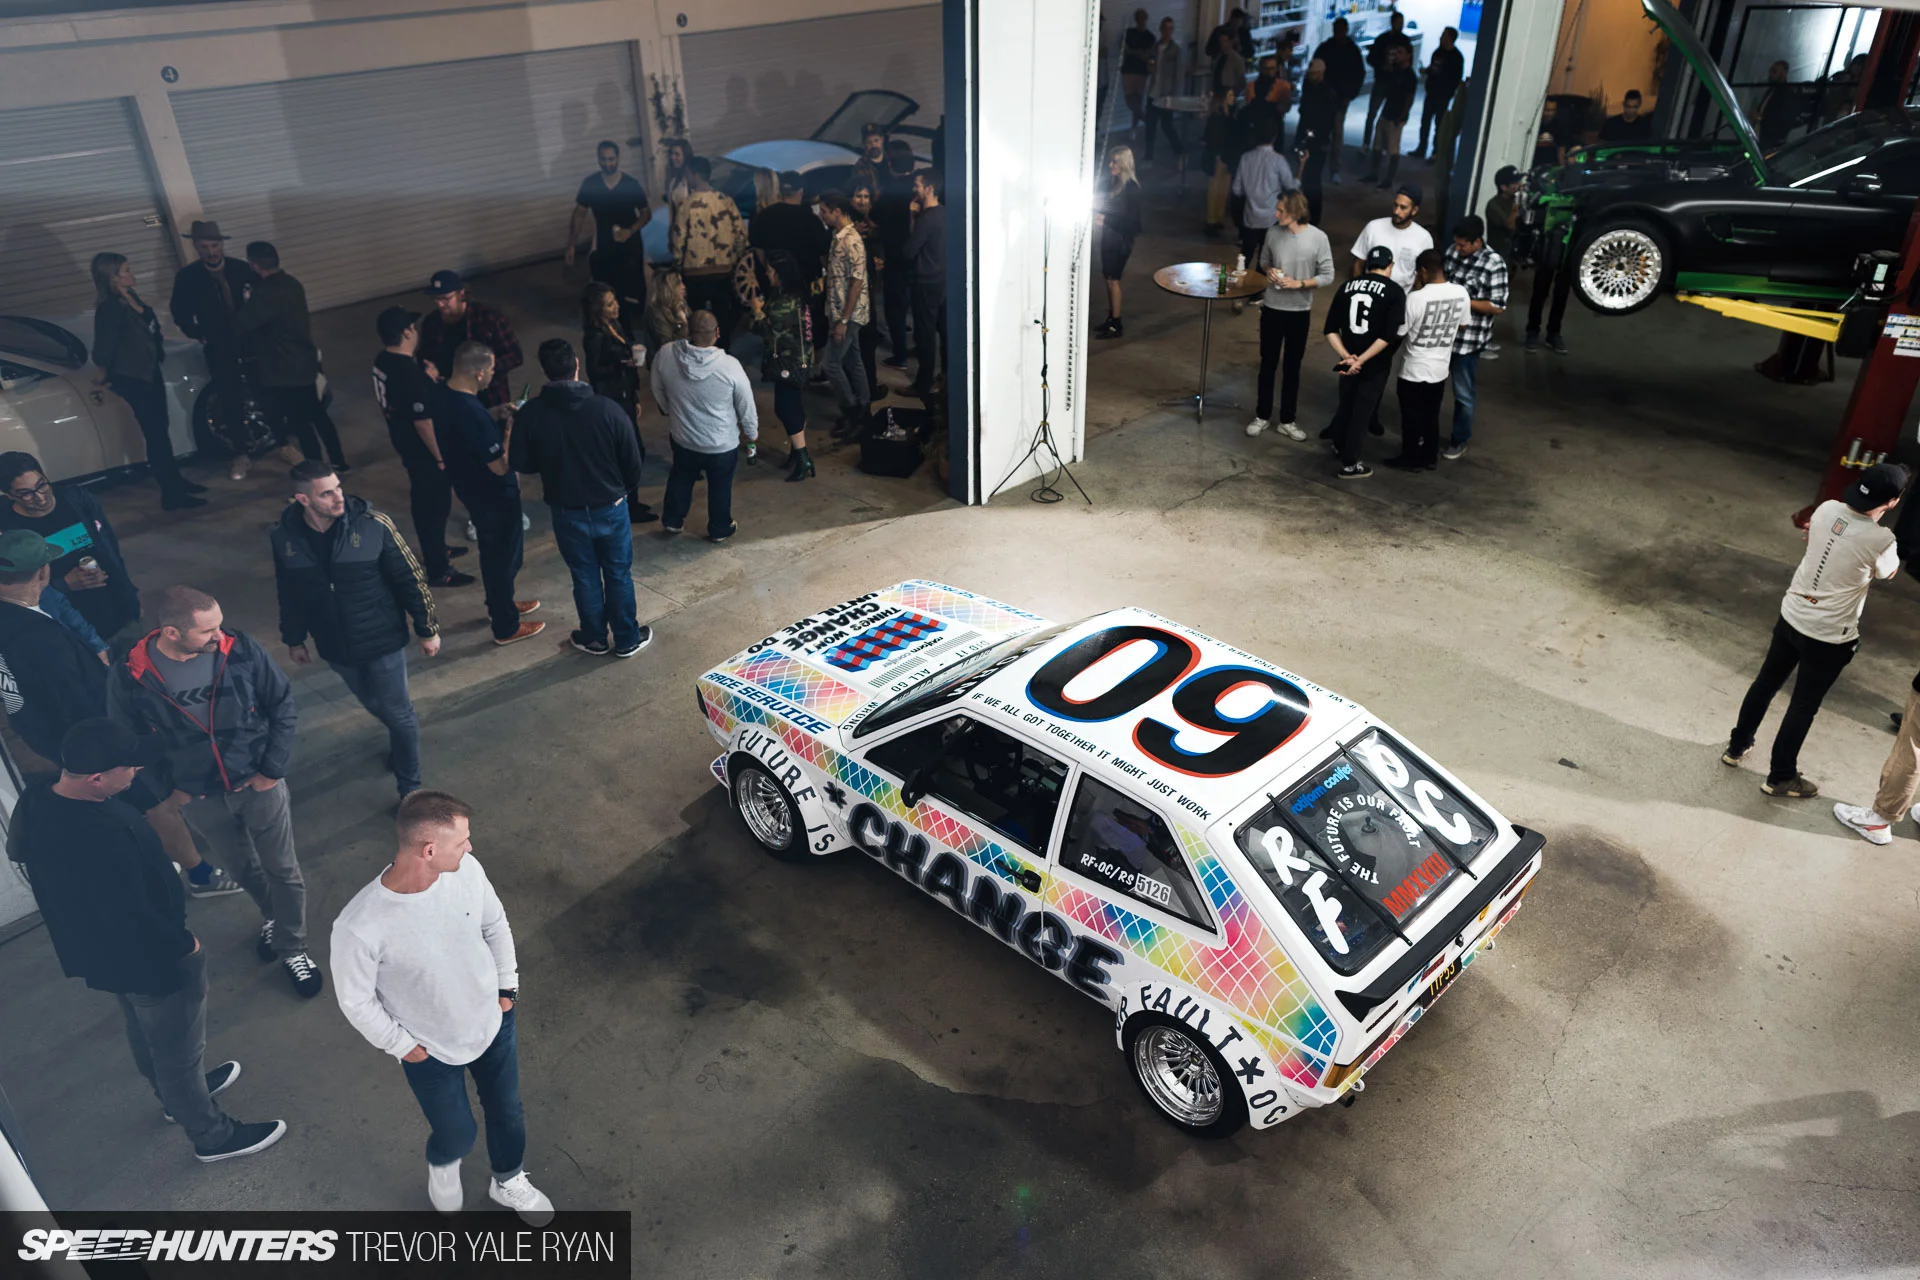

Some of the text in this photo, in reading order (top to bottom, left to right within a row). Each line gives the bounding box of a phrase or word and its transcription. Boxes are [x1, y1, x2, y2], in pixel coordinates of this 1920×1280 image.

[1344, 280, 1369, 293] LIVE
[1421, 297, 1465, 324] ARE
[747, 592, 879, 654] UNTIL WE DO
[783, 602, 880, 651] CHANGE
[955, 649, 968, 659] IT
[704, 672, 744, 689] RACE
[891, 681, 908, 692] GO
[908, 668, 931, 681] ALL
[843, 701, 881, 730] WRONG
[1025, 625, 1313, 779] 09
[971, 692, 1211, 820] IF WE ALL GOT TOGETHER IT MIGHT JUST WORK
[1323, 763, 1354, 789] conifer
[738, 729, 835, 852] FUTURE IS
[1337, 796, 1354, 811] IS
[1356, 794, 1385, 810] OUR
[1326, 808, 1350, 862] FUTURE
[1349, 862, 1379, 885] THE
[1382, 851, 1450, 919] MMXVIII
[847, 802, 1125, 1002] CHANGE
[1136, 875, 1170, 902] 5126
[1262, 826, 1350, 954] RF
[1141, 984, 1243, 1051] FAULT
[1250, 1089, 1287, 1125] OC
